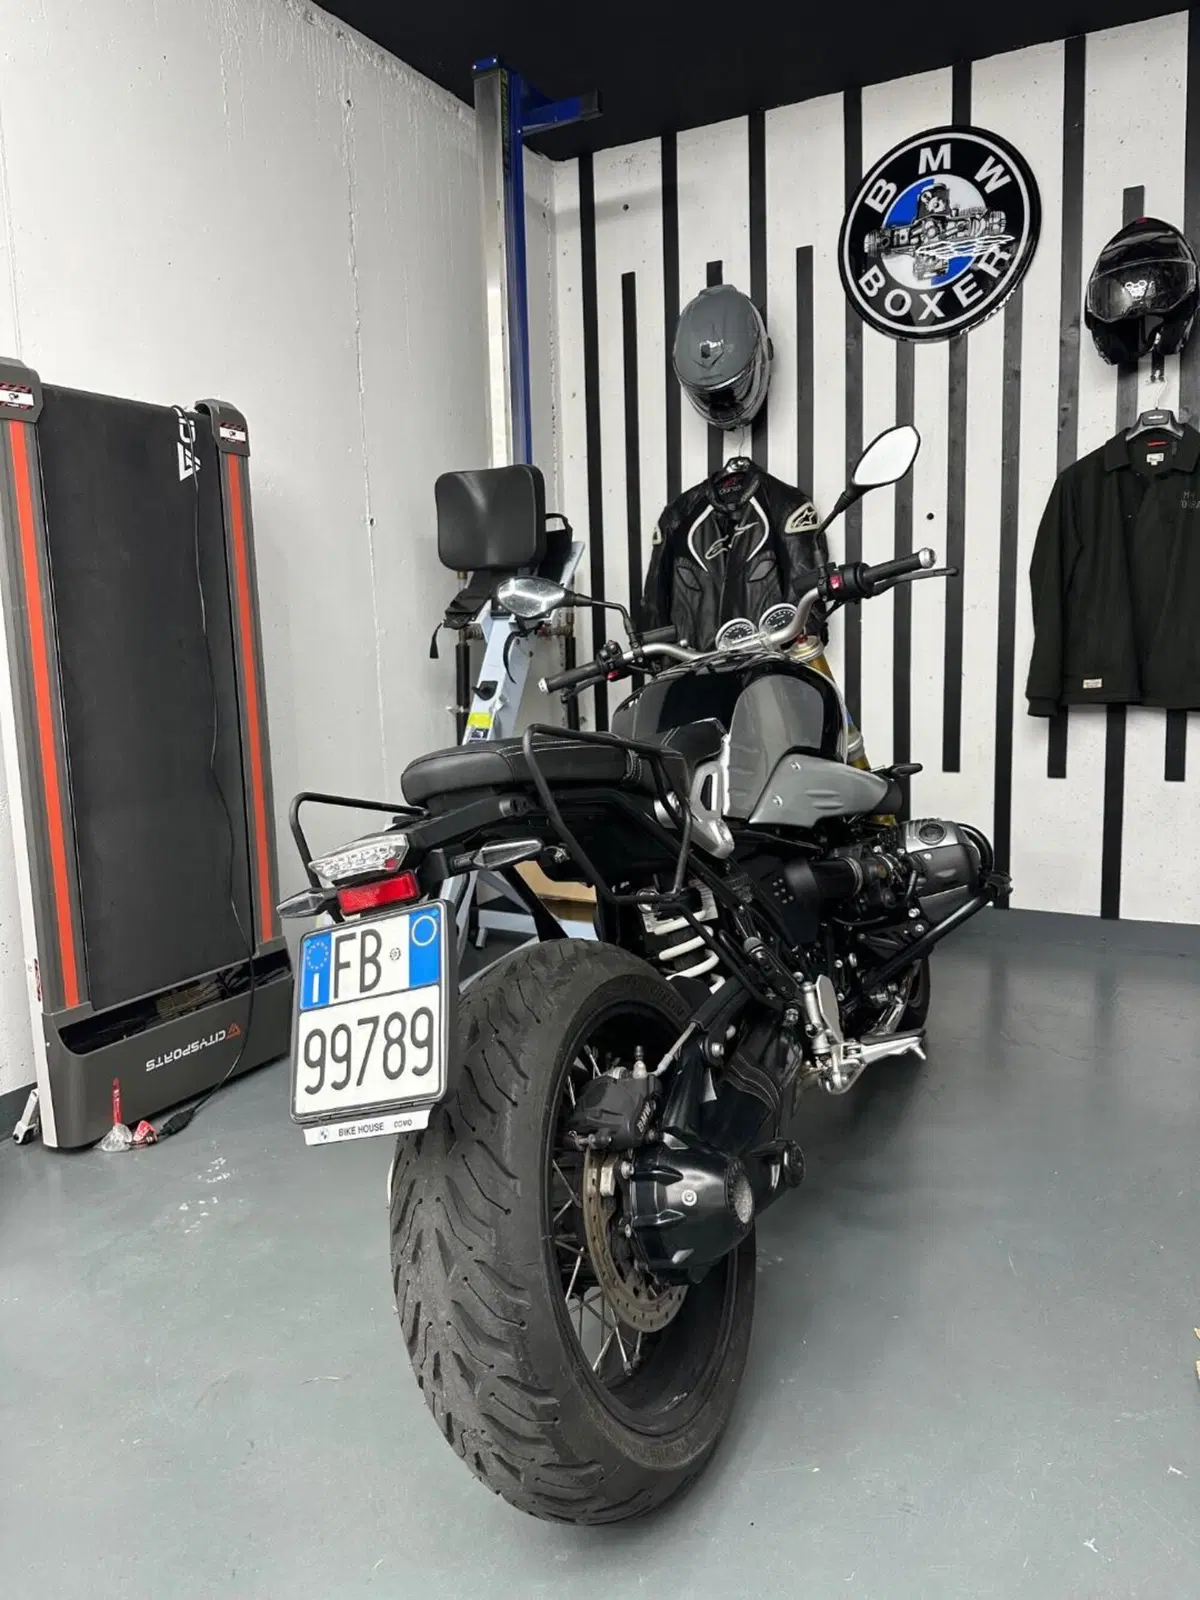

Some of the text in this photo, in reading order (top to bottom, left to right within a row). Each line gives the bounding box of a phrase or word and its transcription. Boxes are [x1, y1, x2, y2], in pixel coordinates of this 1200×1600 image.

[864, 143, 1012, 214] BMW
[858, 244, 1012, 321] BOXER
[333, 928, 383, 999] FB
[145, 1030, 227, 1072] CITYSPORTS
[303, 1006, 434, 1096] 99789
[338, 1125, 357, 1137] BIKE
[357, 1122, 385, 1134] HOUSE
